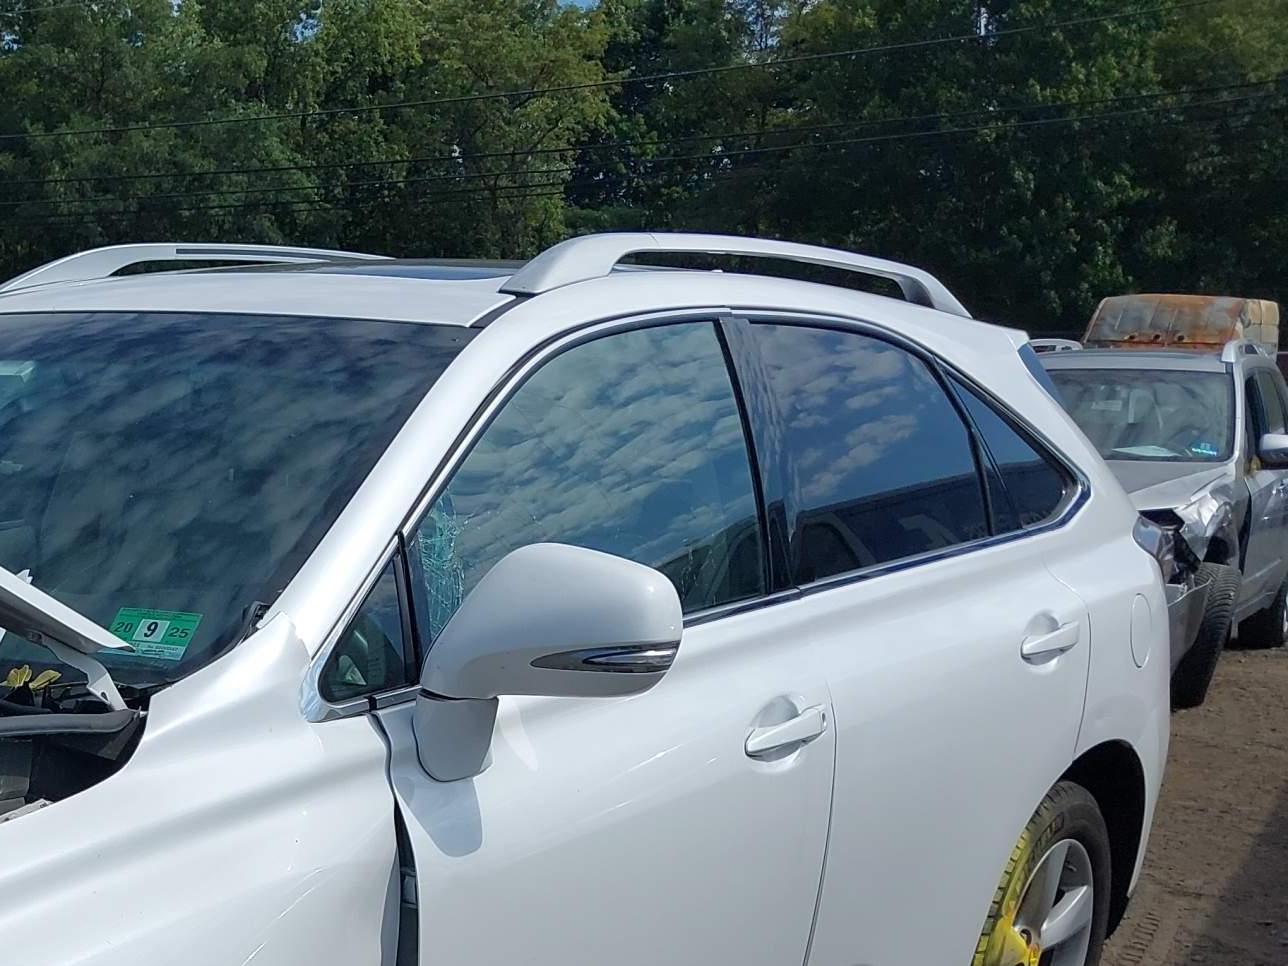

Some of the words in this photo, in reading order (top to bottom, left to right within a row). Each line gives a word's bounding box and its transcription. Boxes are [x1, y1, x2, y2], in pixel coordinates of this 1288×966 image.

[114, 622, 133, 634] 20
[144, 621, 159, 638] 9
[168, 627, 190, 639] 25
